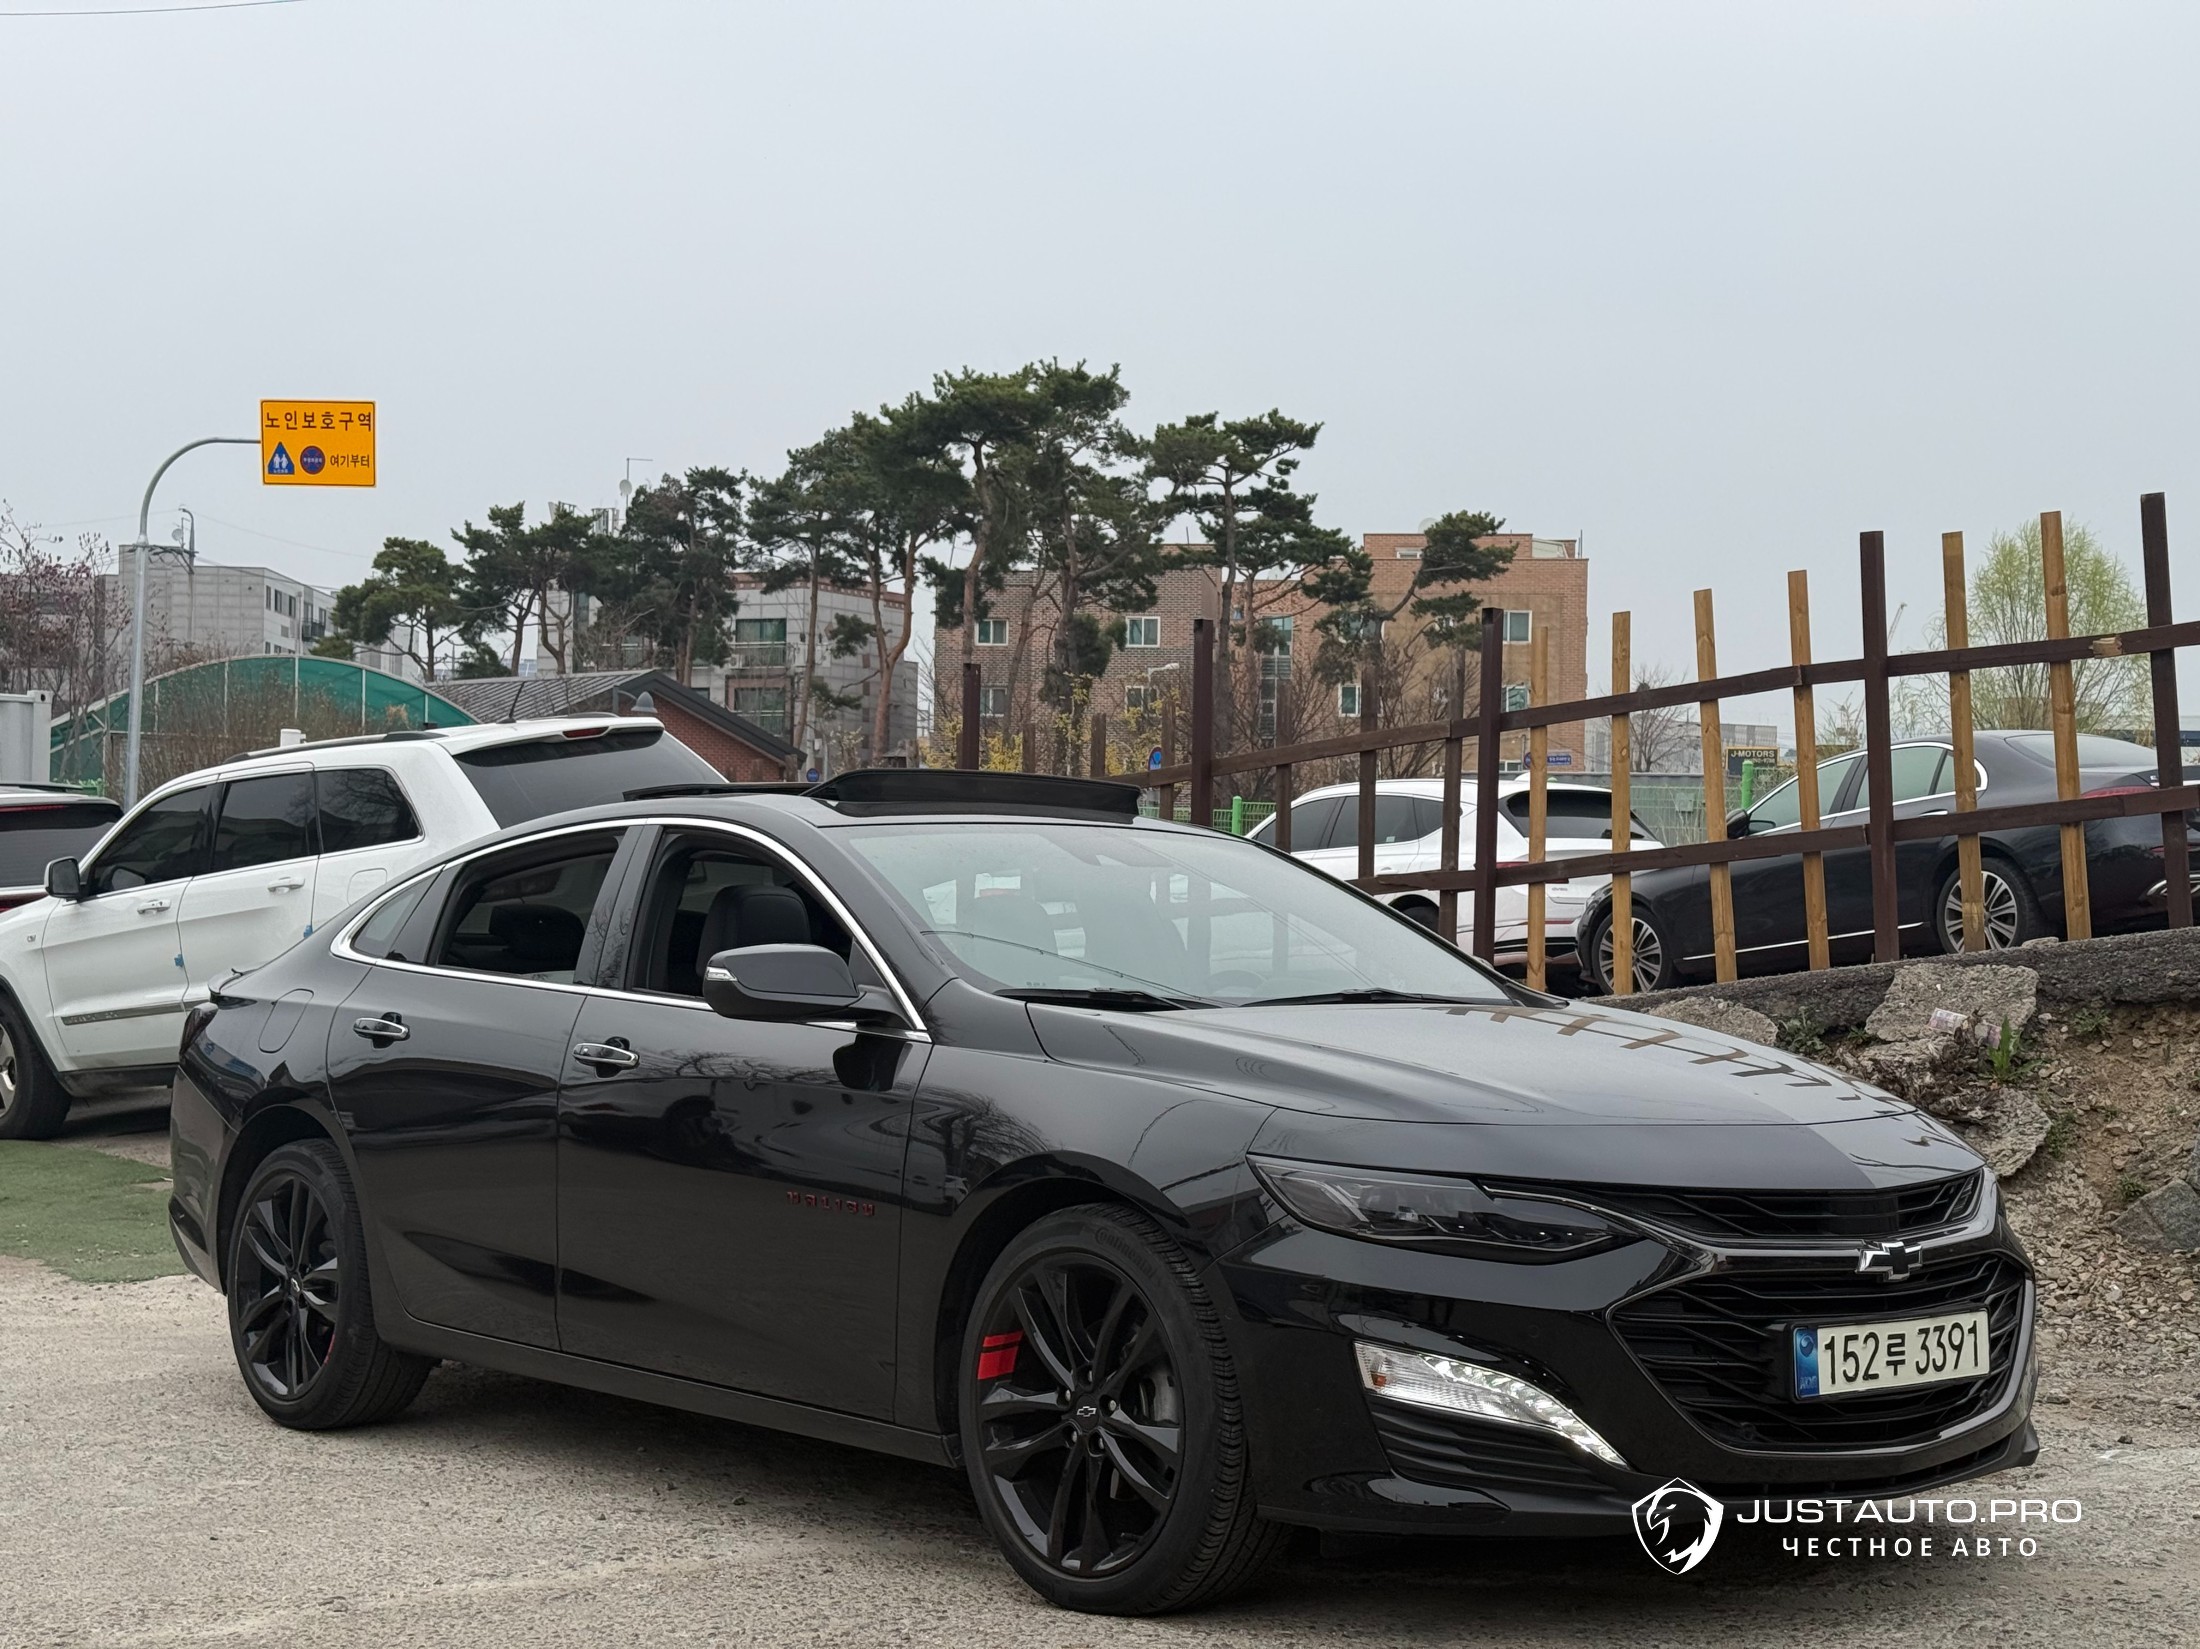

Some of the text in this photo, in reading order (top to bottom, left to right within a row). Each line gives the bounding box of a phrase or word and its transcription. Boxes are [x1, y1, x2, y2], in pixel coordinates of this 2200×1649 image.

[265, 410, 372, 432] 노인보호구역
[330, 454, 370, 468] 여기부터
[1731, 750, 1775, 758] J-MOTORS
[1824, 1320, 1979, 1385] 152루 3391
